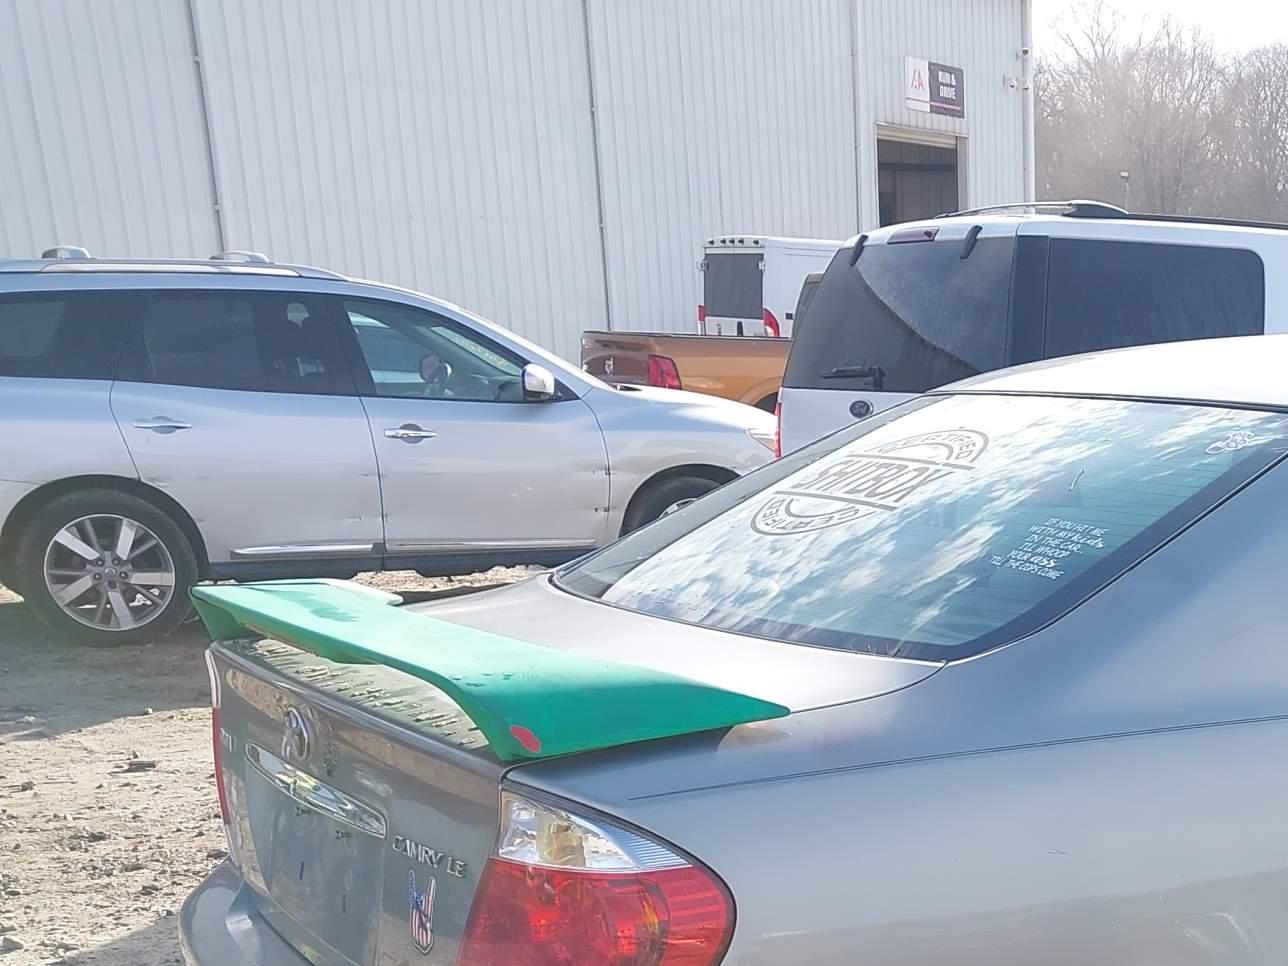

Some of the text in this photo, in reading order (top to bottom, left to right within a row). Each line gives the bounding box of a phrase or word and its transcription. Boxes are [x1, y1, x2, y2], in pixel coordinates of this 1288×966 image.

[939, 85, 957, 100] DRIVE
[789, 458, 955, 503] SHITBOX
[762, 497, 861, 531] CERTIFIED
[1028, 525, 1105, 549] WITH MY kids
[1057, 520, 1076, 530] YOU
[1073, 523, 1094, 533] HIT
[1090, 528, 1109, 537] ME
[1025, 534, 1042, 542] IN
[1041, 537, 1064, 548] THE
[1006, 549, 1059, 568] YOUR ass
[1035, 546, 1071, 559] WHOOP
[1018, 562, 1042, 574] COPS
[1037, 568, 1064, 580] COME
[392, 835, 465, 878] CAMRY LE
